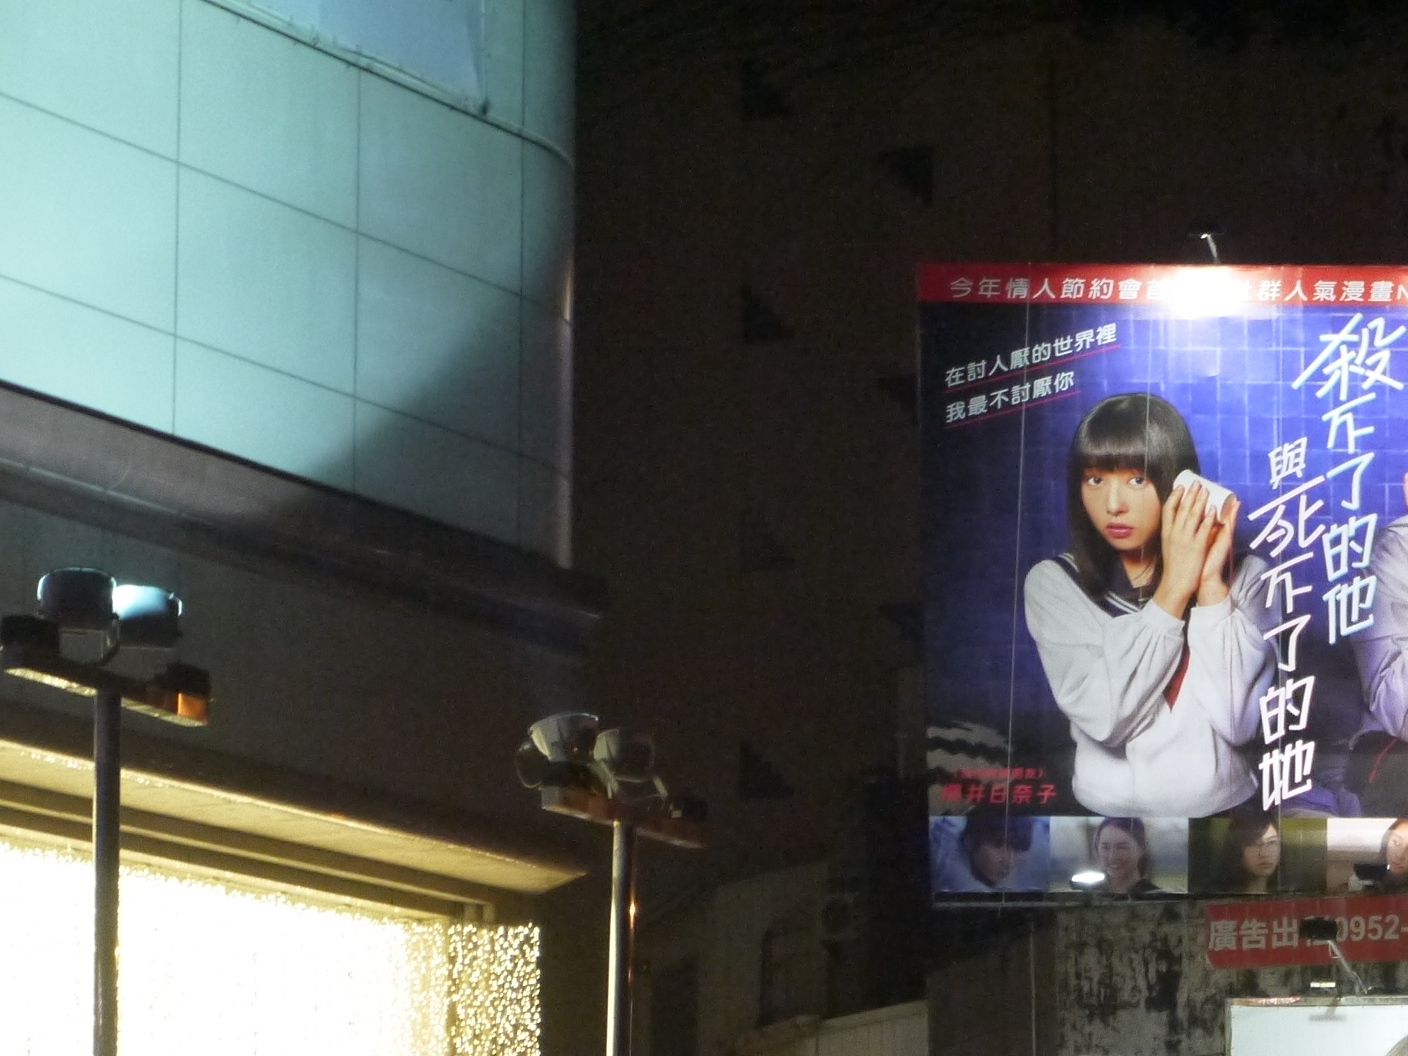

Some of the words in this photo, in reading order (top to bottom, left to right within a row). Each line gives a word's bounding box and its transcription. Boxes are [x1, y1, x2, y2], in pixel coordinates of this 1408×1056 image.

[949, 275, 1199, 301] 今年情人節約會首
[944, 321, 1118, 389] 在討人厭的世界裡
[944, 370, 1076, 425] 我最不討厭你
[1207, 914, 1334, 951] 廣告出
